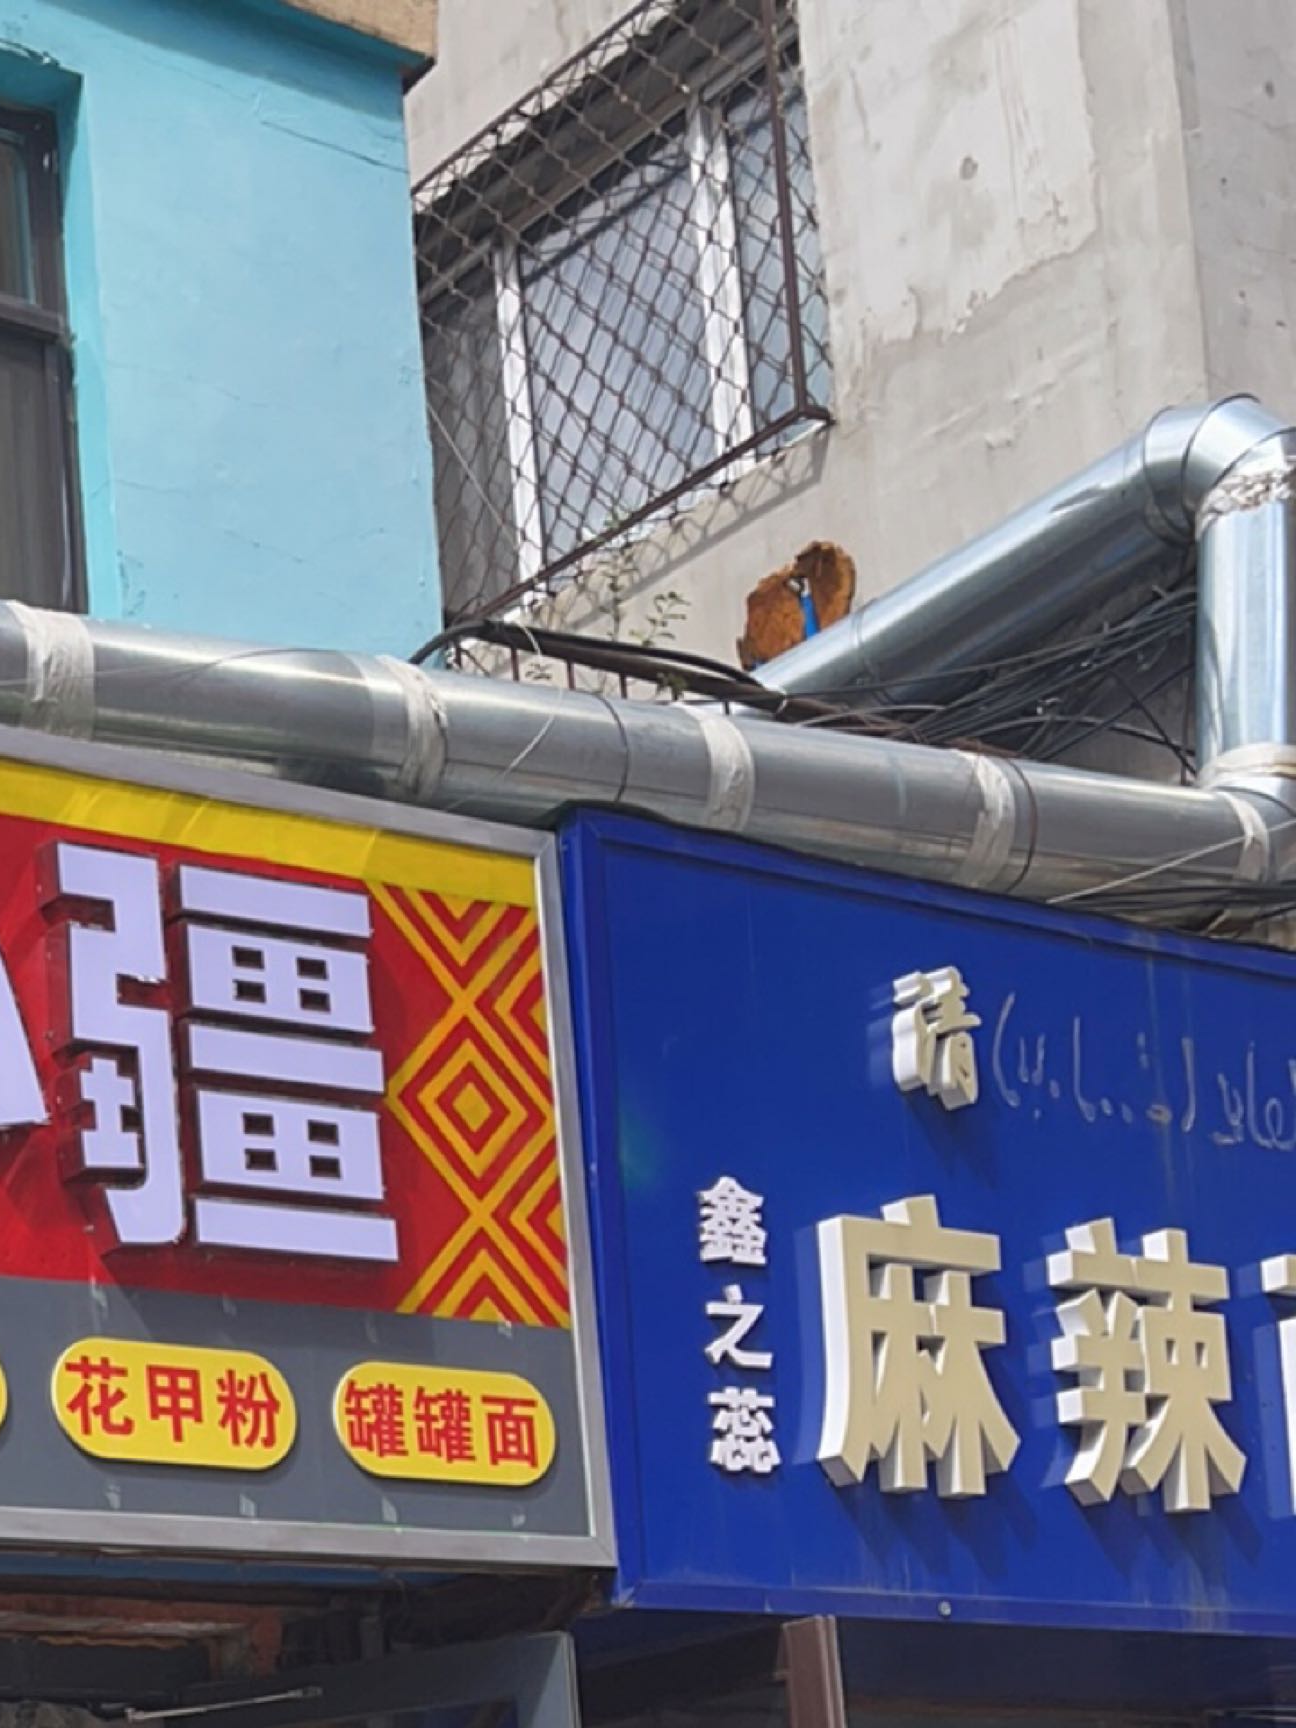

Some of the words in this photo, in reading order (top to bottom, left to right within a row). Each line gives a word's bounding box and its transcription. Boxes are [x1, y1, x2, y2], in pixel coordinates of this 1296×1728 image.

[65, 1355, 281, 1450] 花甲粉
[697, 1176, 781, 1474] 鑫之蕊
[817, 1194, 1296, 1518] 麻辣
[344, 1378, 539, 1469] 罐罐面
